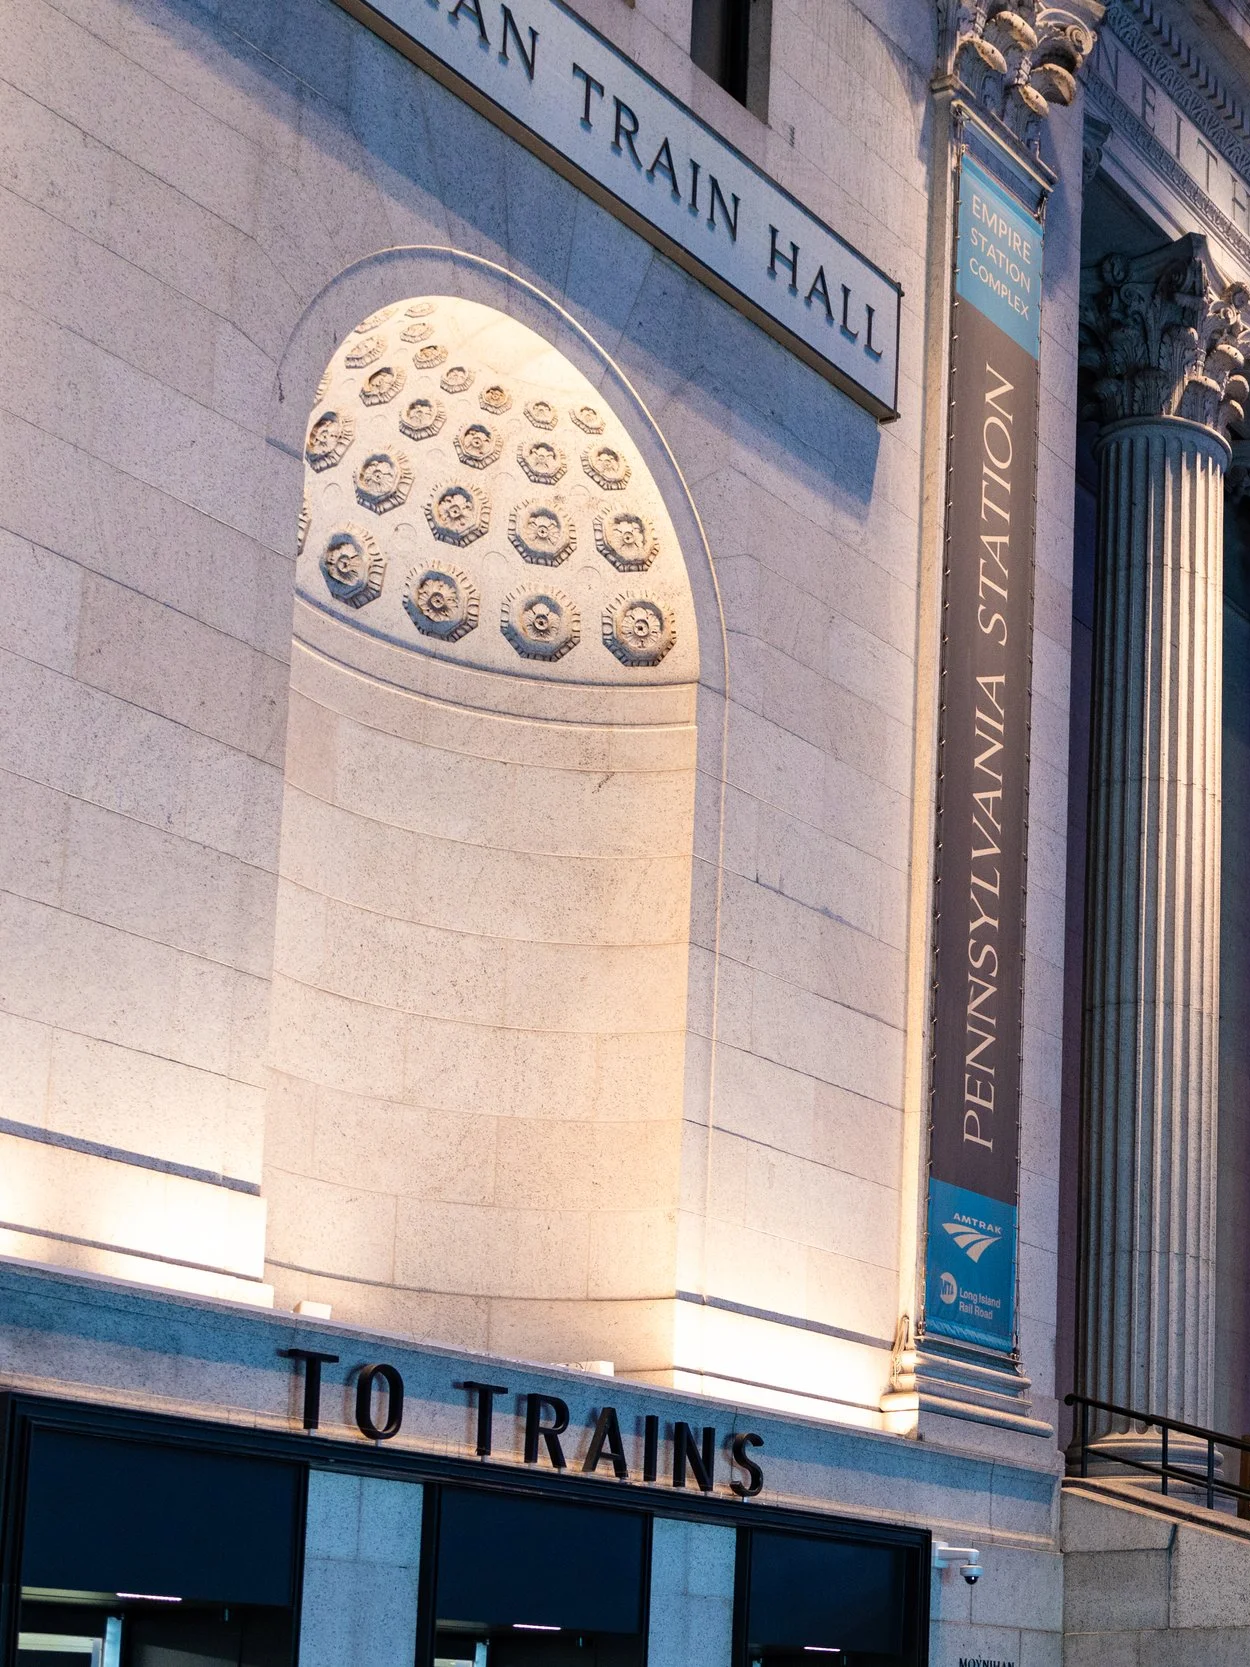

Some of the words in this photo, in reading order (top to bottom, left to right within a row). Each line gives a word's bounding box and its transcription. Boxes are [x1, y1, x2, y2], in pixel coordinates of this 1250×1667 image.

[446, 0, 540, 80] AN
[572, 62, 741, 242] TRAIN
[767, 224, 882, 357] HALL
[970, 227, 1031, 293] STATION
[972, 194, 1032, 264] EMPIRE
[969, 256, 1029, 321] COMPLEX
[977, 362, 1015, 646] STATION
[963, 672, 1006, 1153] PENNSYLVANIA
[953, 1212, 1002, 1235] AMTRAK
[959, 1287, 978, 1305] Long
[979, 1293, 1001, 1309] Island
[959, 1300, 973, 1315] Rail
[974, 1305, 993, 1320] Road
[287, 1348, 405, 1440] TO
[463, 1380, 765, 1497] TRAINS
